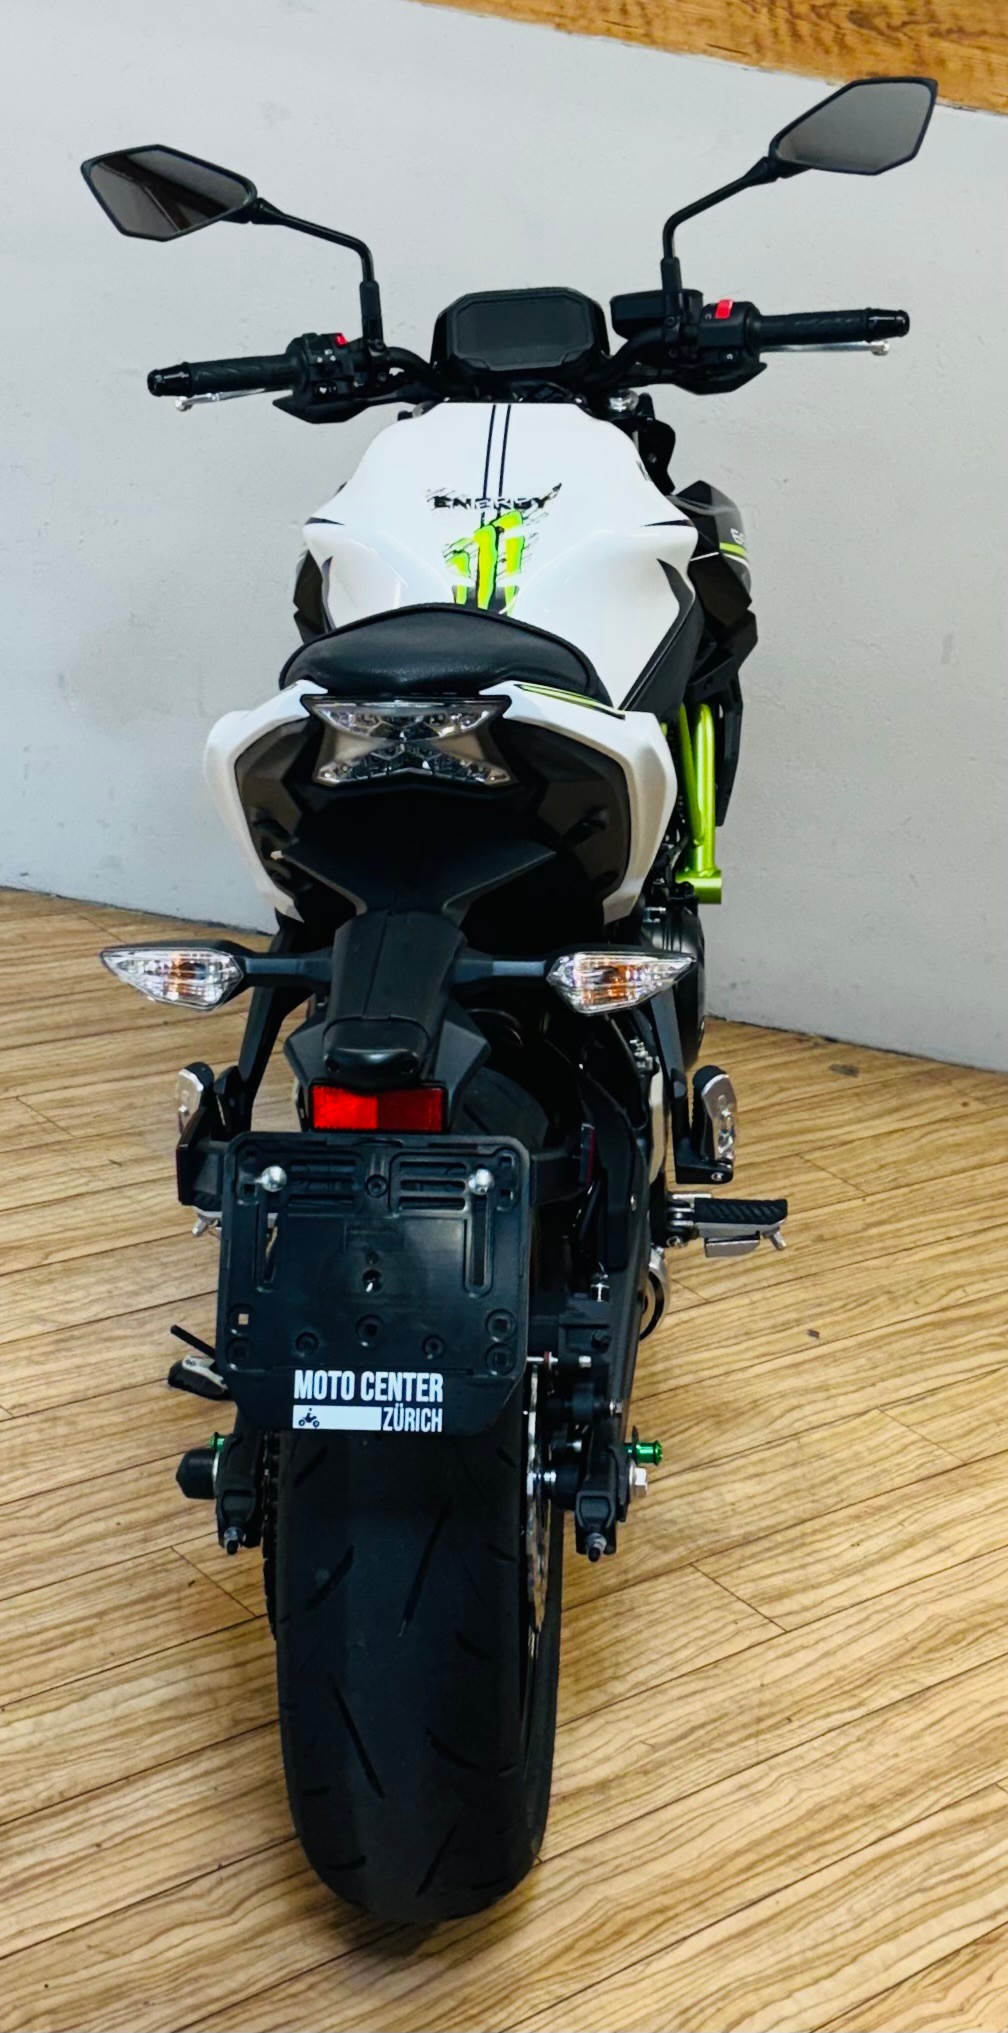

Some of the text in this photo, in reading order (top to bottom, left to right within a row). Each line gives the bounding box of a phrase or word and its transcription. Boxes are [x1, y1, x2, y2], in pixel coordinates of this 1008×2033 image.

[431, 487, 560, 510] ENERGY
[293, 1369, 444, 1403] MOTO CENTER
[382, 1403, 443, 1433] ZÜRICH
